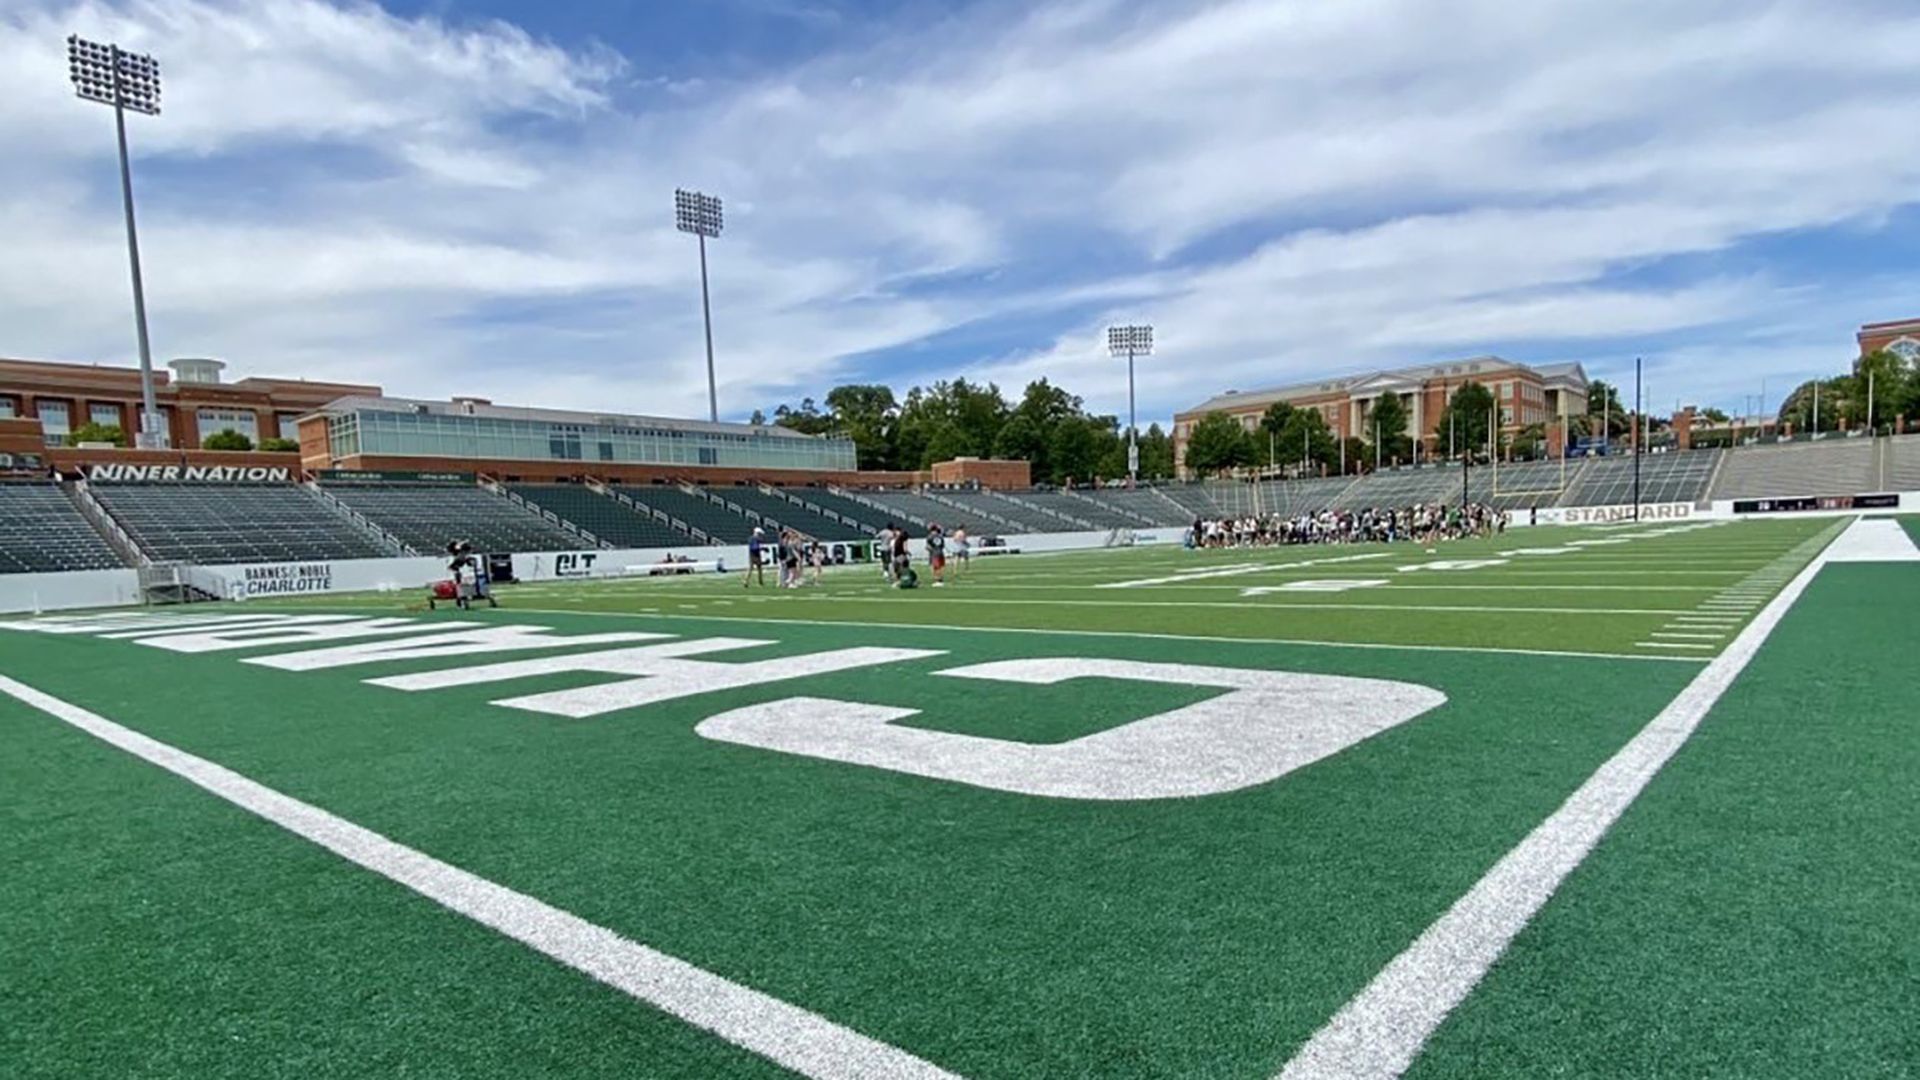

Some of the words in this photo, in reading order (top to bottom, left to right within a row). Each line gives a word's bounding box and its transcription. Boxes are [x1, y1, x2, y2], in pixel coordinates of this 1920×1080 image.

[90, 464, 179, 481] NINER
[184, 466, 288, 481] NATION
[1565, 504, 1690, 522] STANDARD
[245, 566, 287, 580] BARNES
[299, 564, 330, 577] NOBLE
[247, 578, 331, 594] CHARLOTTE
